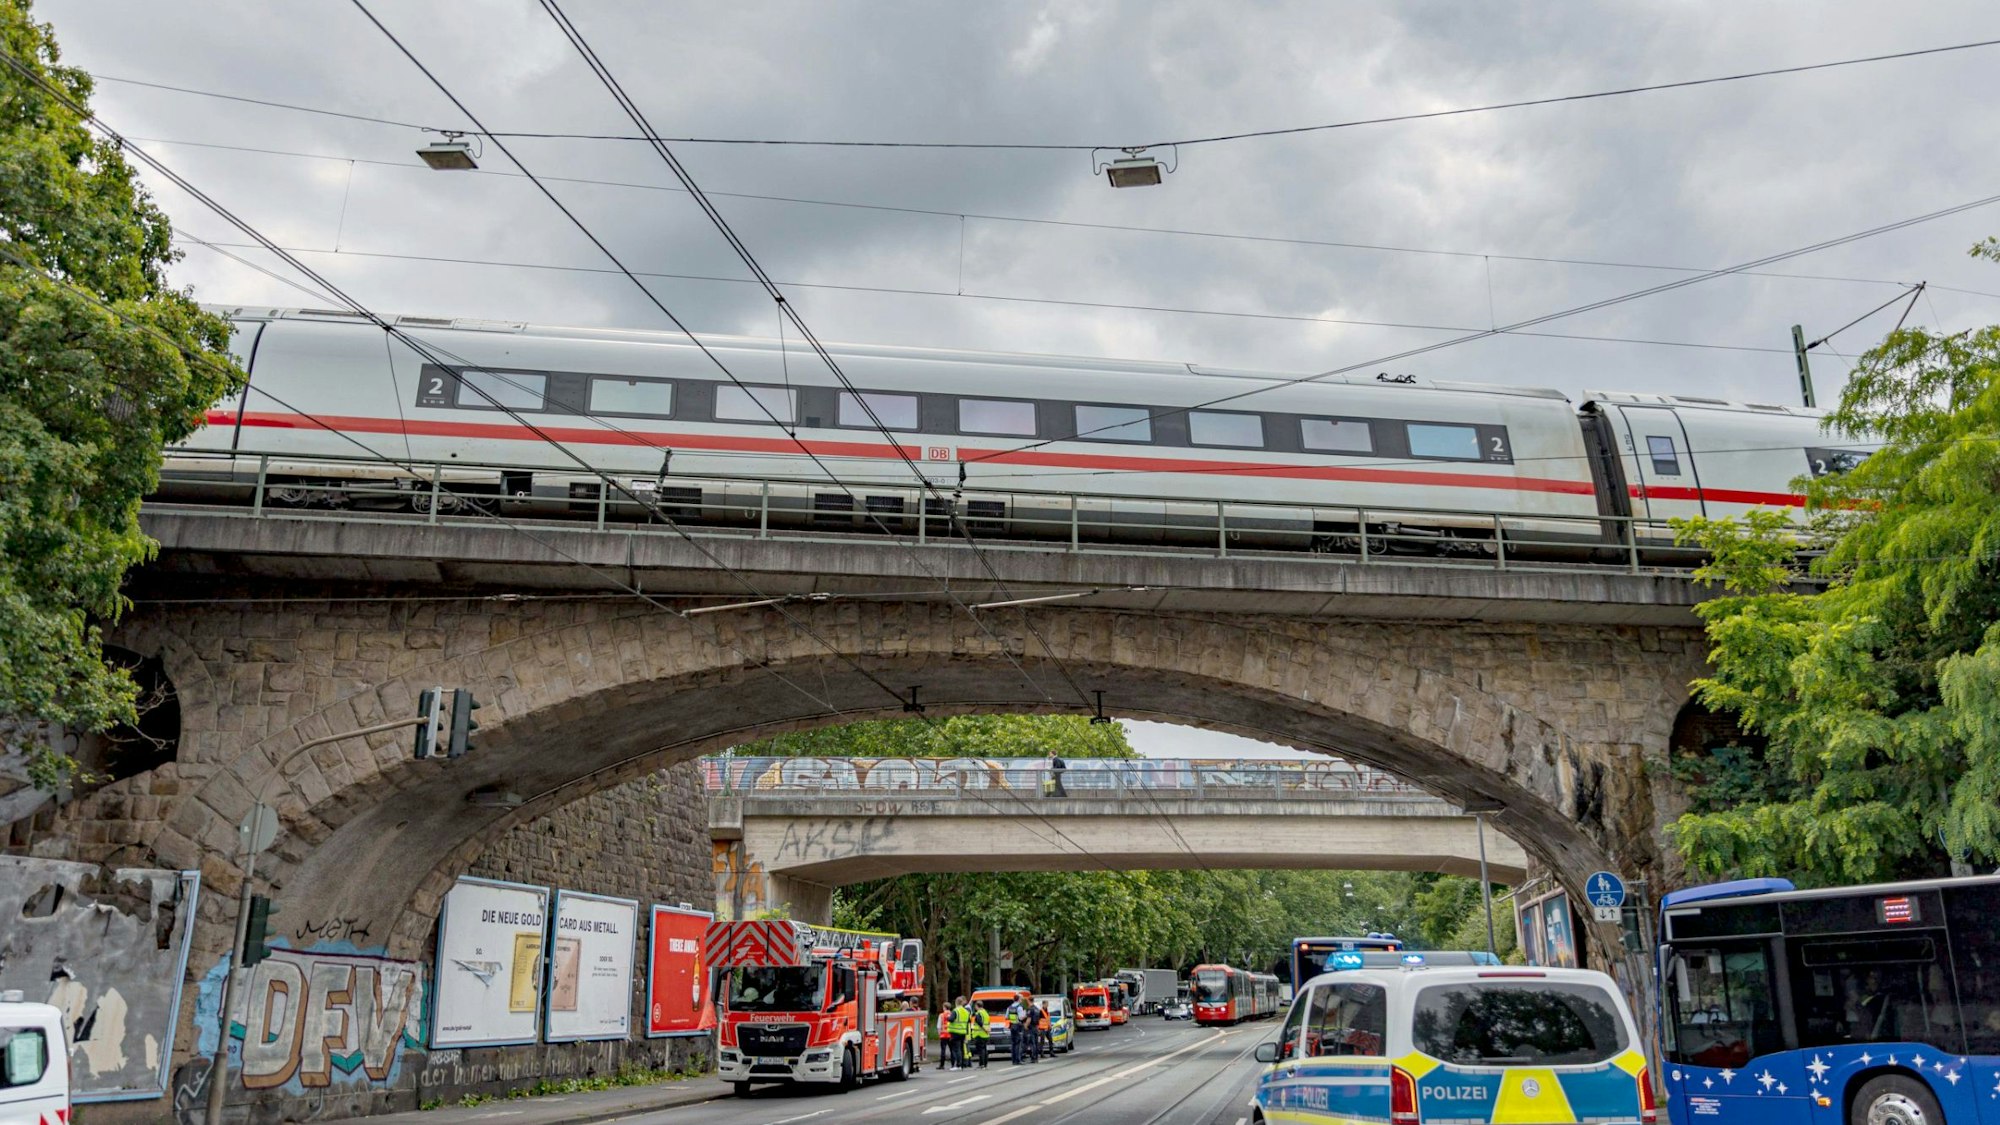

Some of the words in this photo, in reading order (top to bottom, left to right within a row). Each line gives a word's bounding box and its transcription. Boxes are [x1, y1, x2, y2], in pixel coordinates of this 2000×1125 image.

[429, 377, 443, 395] 2
[1491, 437, 1504, 452] 2
[930, 448, 948, 460] DB
[1816, 459, 1828, 474] 2
[482, 909, 496, 924] DIE
[498, 911, 519, 925] NEUE
[521, 913, 541, 926] GOLD
[560, 917, 577, 930] CARD
[579, 920, 592, 932] AUS
[594, 921, 619, 934] METALL.
[750, 1012, 796, 1023] Feuerwehr
[1302, 1087, 1329, 1109] POLIZEI
[1422, 1086, 1487, 1100] POLIZEI
